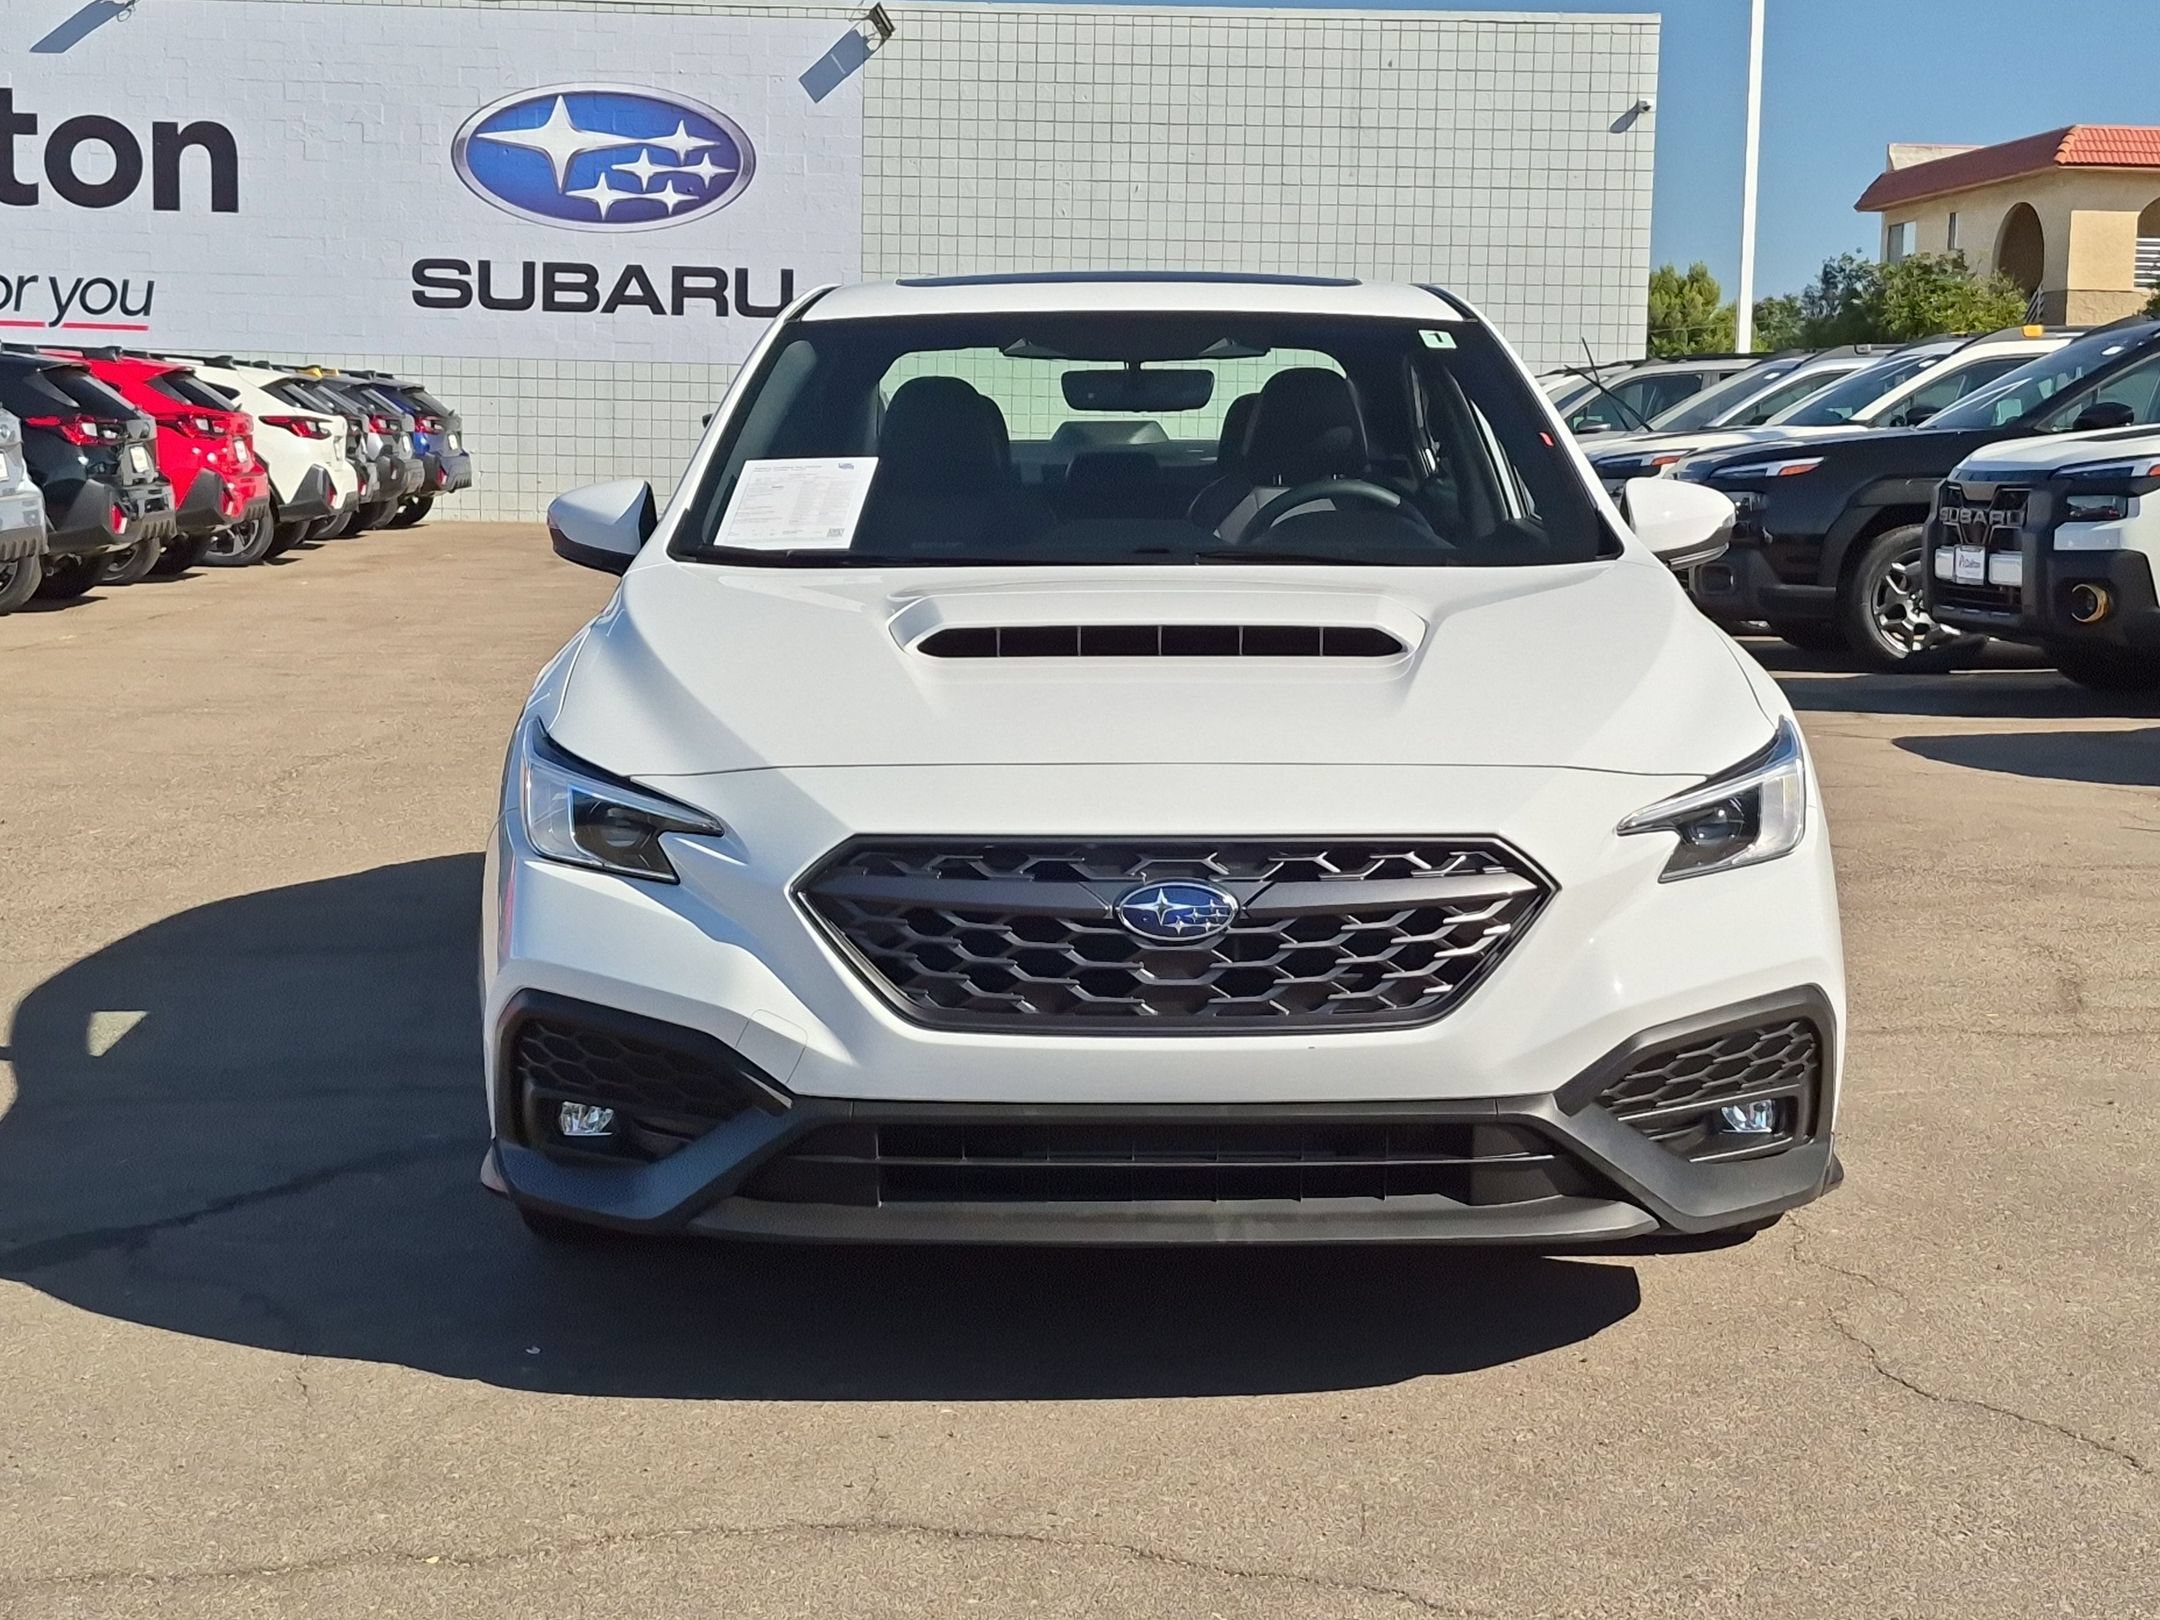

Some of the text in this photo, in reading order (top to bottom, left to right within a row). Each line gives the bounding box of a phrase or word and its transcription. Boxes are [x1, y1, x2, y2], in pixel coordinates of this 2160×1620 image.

[48, 276, 155, 327] you
[411, 258, 794, 318] SUBARU
[1939, 506, 2025, 526] SUBARU
